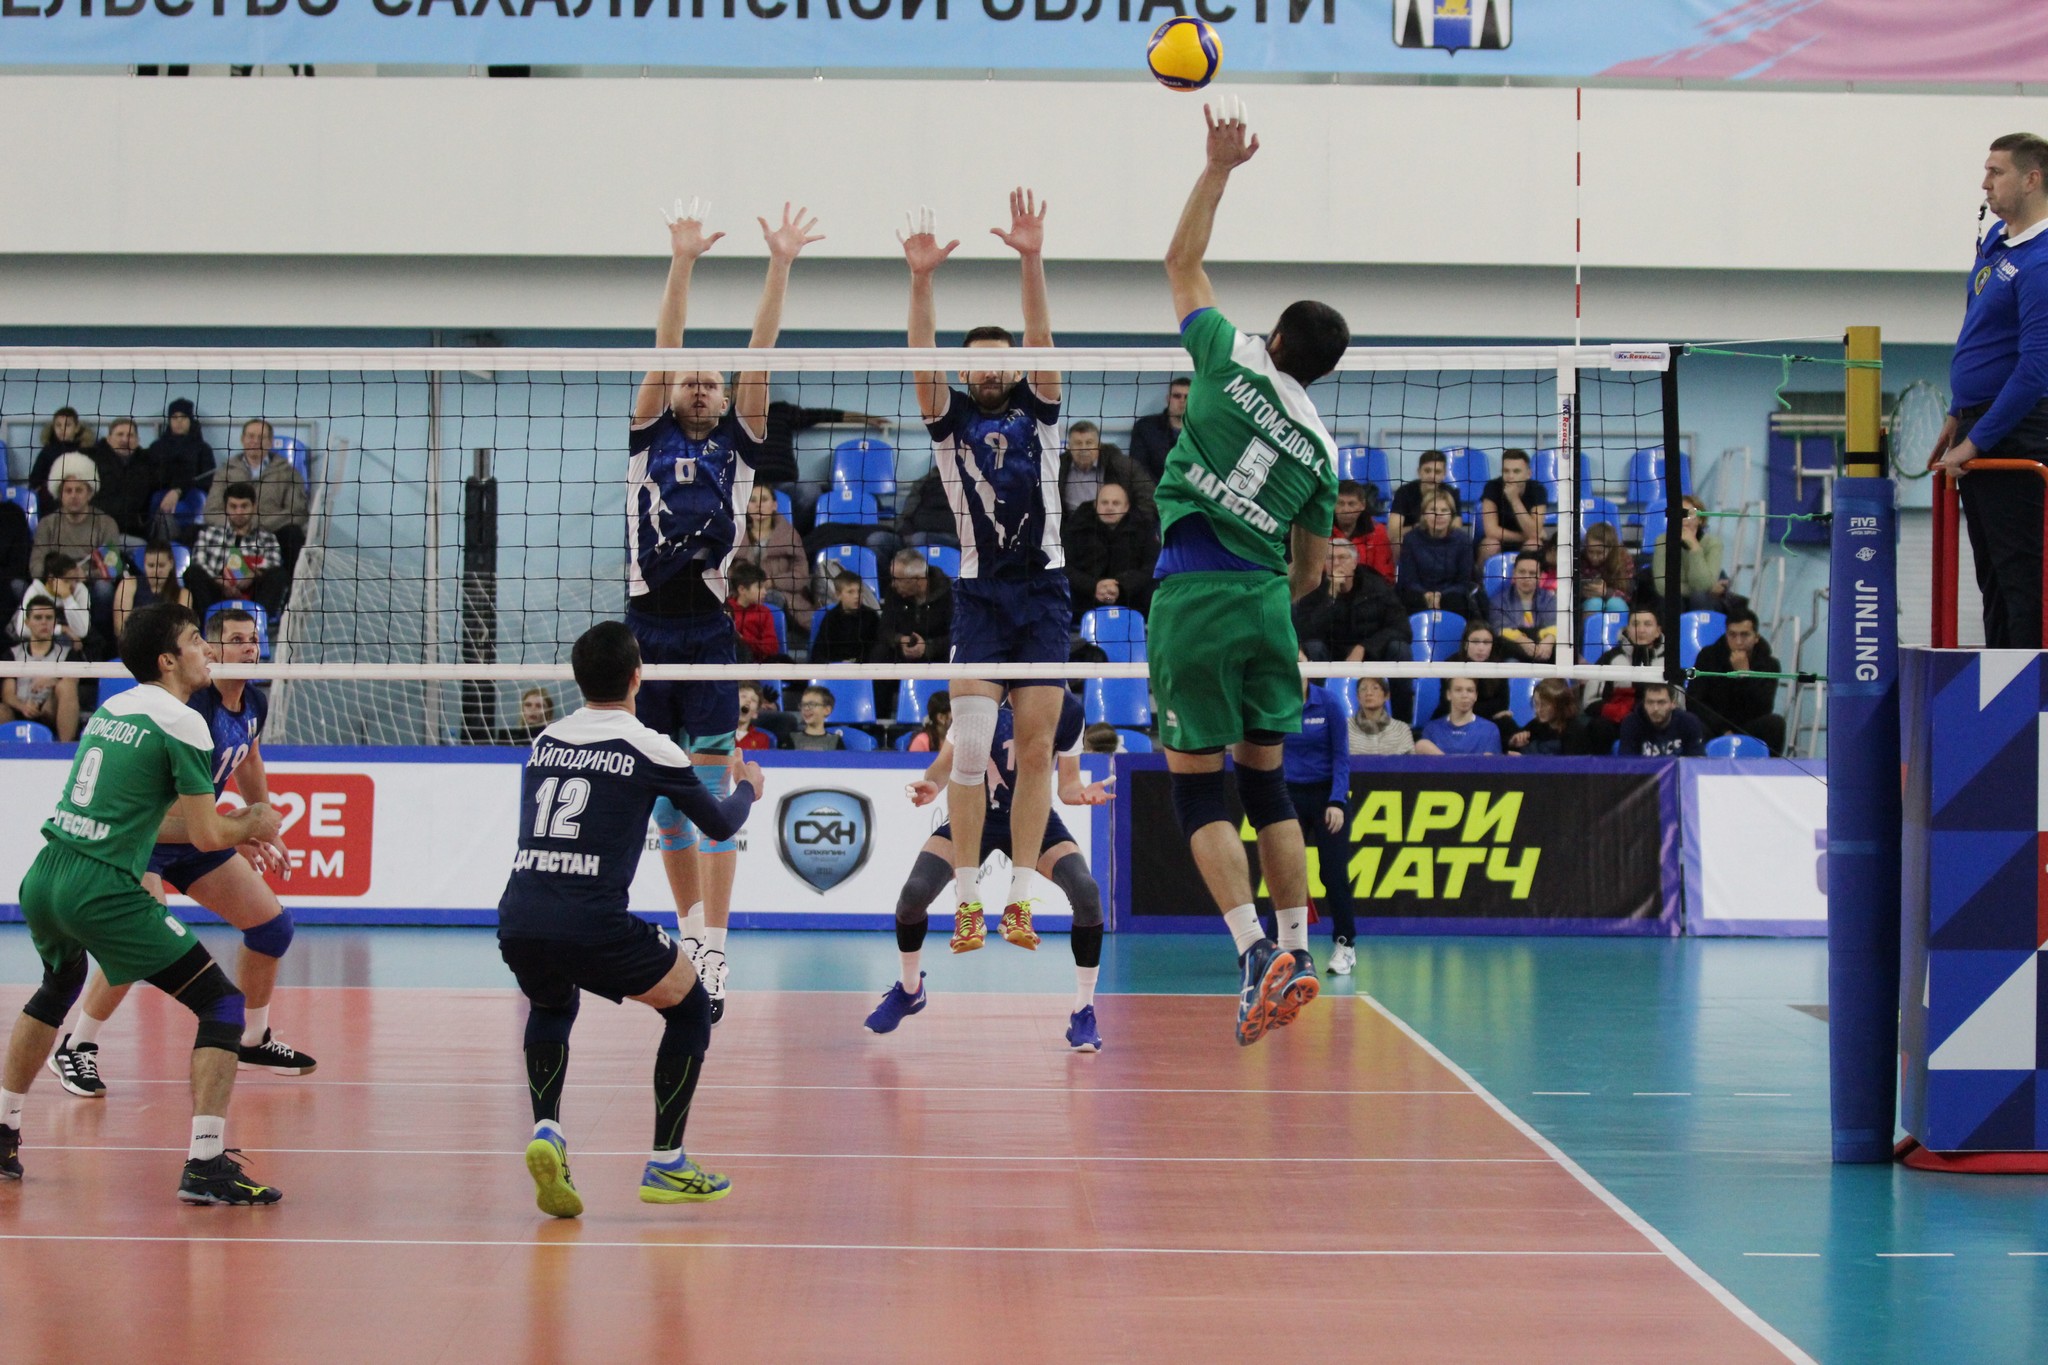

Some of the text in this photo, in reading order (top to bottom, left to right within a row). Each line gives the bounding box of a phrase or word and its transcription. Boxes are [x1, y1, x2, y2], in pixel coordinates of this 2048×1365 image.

[1223, 374, 1315, 466] МАГОМЕДОВ
[1226, 436, 1279, 500] 5
[1855, 579, 1879, 681] JINLING
[70, 746, 104, 808] 9
[526, 742, 635, 777] АЙПОДИНОВ
[533, 776, 592, 840] 12
[1240, 790, 1525, 843] АРИ
